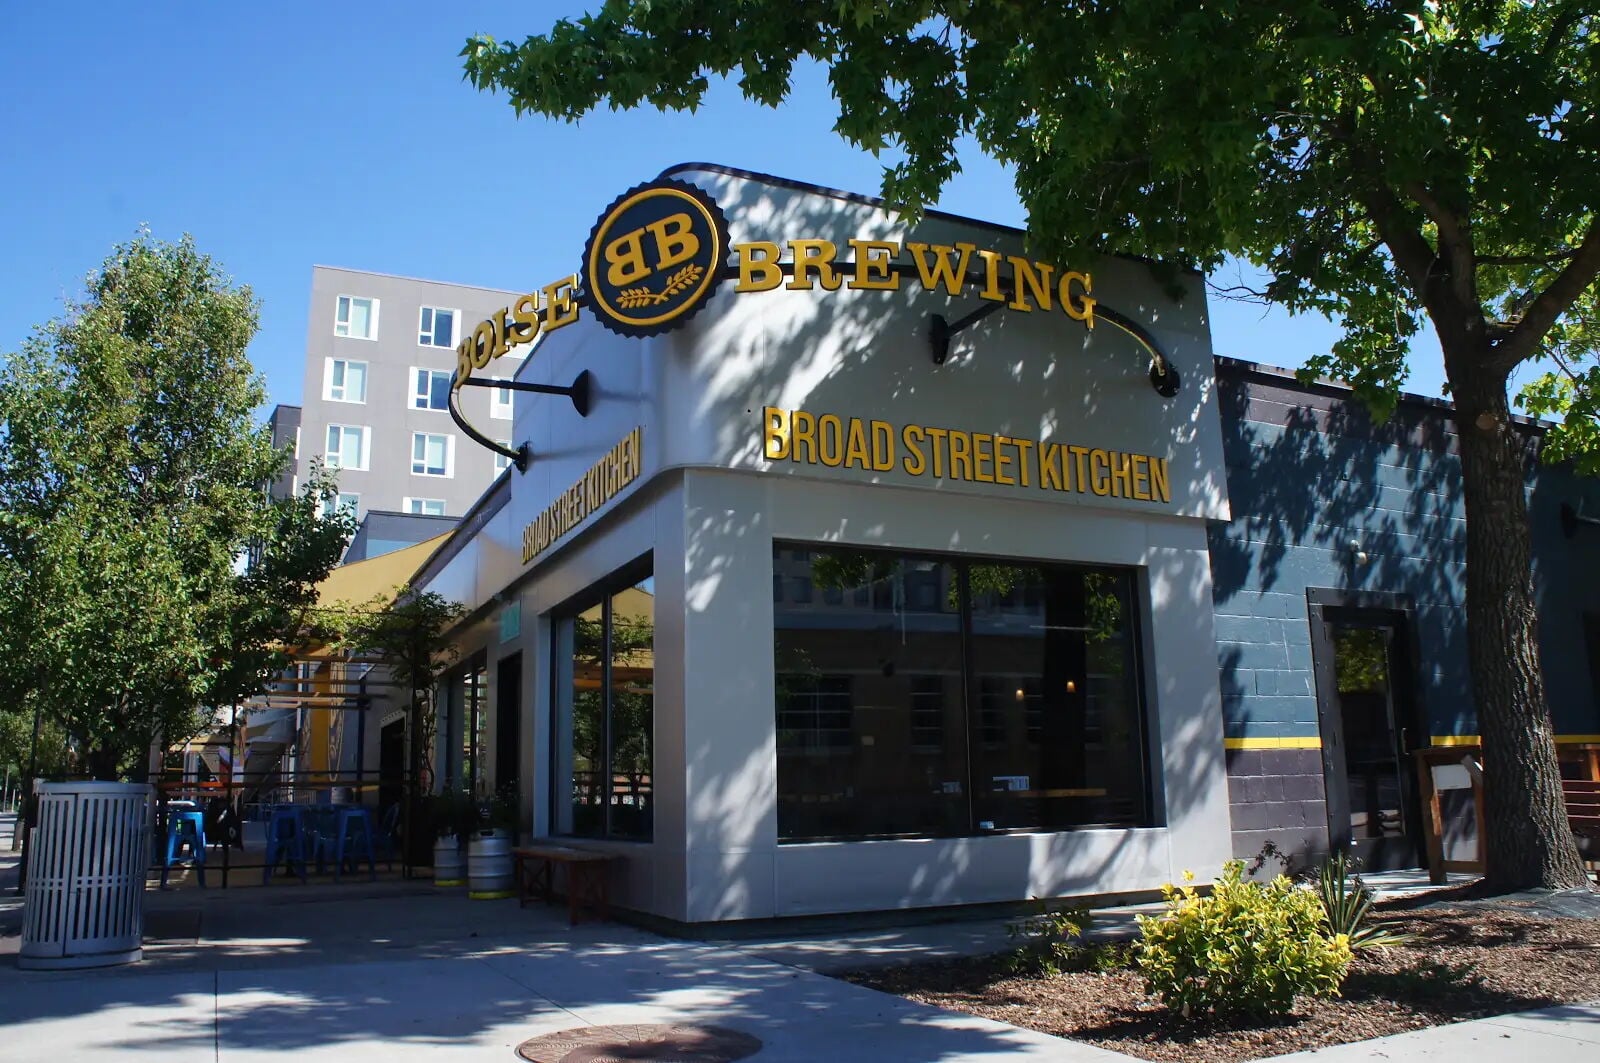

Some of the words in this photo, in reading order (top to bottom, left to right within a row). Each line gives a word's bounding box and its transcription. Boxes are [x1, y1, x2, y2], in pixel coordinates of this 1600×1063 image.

[454, 273, 579, 388] BOISE
[734, 239, 1096, 329] BREWING
[521, 507, 551, 565] BROAD
[549, 472, 589, 541] STREET
[587, 425, 641, 514] KITCHEN
[763, 406, 895, 472] BROAD
[902, 424, 1032, 487] STREET
[1037, 441, 1171, 503] KITCHEN
